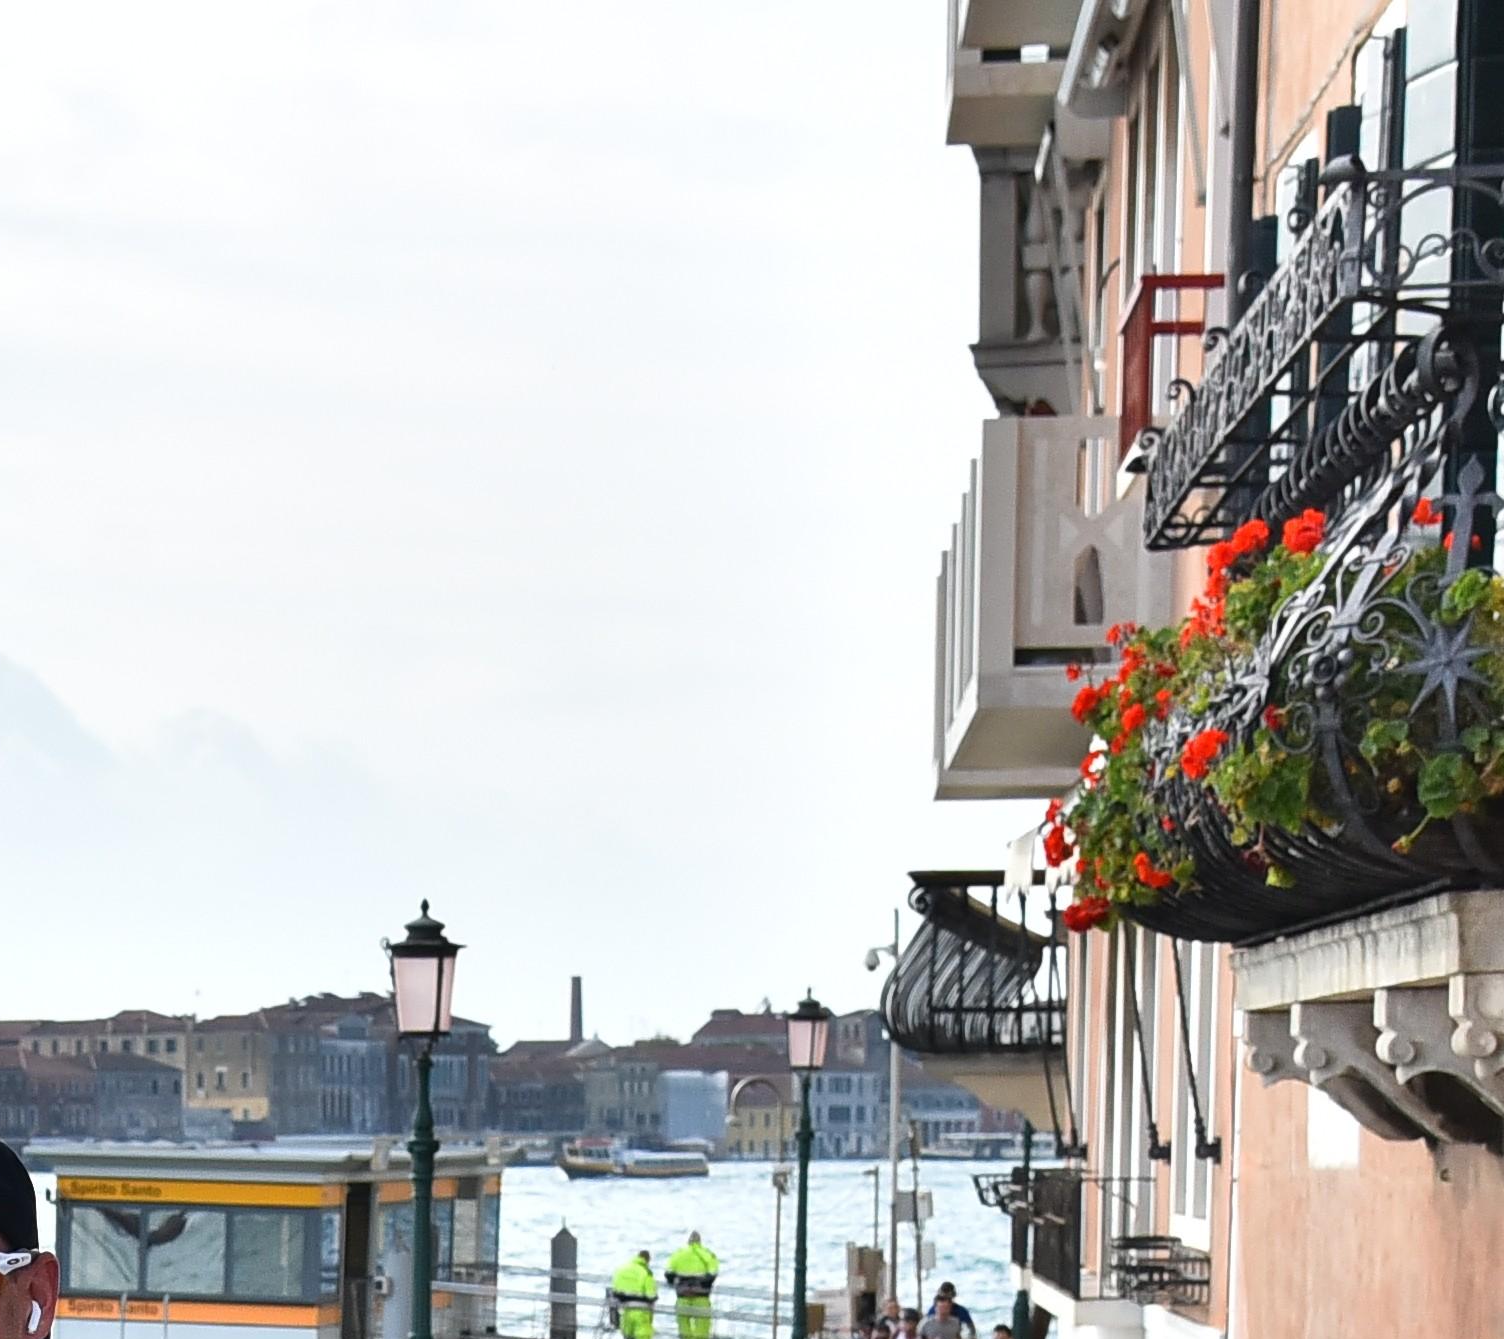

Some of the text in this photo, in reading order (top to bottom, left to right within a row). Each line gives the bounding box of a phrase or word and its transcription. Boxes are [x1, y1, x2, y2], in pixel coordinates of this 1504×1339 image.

[70, 1181, 162, 1197] Spirito Santo
[68, 1300, 159, 1315] Spirito anto
